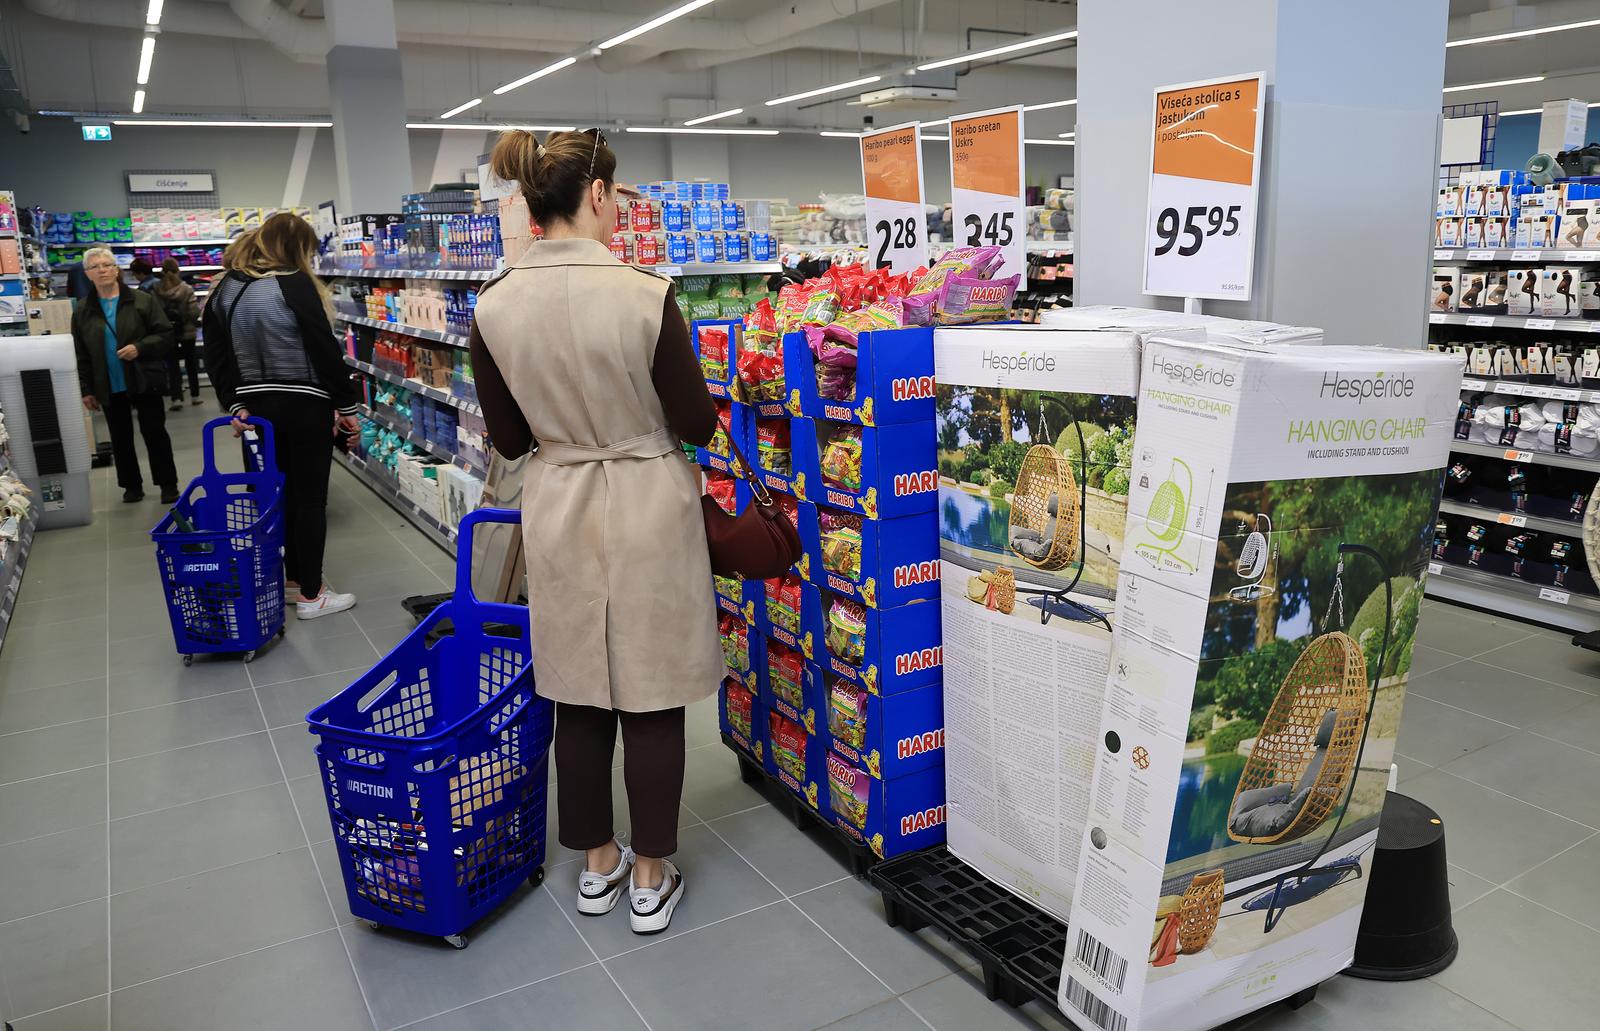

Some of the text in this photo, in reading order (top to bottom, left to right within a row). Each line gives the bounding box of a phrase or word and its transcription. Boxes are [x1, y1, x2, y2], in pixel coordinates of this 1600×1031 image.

[1160, 90, 1241, 110] Viseća stolica s
[956, 122, 1000, 136] Haribo sretan
[865, 134, 914, 150] Haribo pearl eggs
[955, 136, 974, 148] Uskrs
[637, 216, 650, 226] BAR
[668, 216, 681, 225] BAR
[698, 216, 710, 225] BAR
[724, 216, 736, 224] BAR
[642, 249, 656, 258] BAR
[674, 248, 686, 258] BAR
[702, 248, 715, 257] BAR
[728, 248, 740, 256] BAR
[756, 246, 768, 255] BAR
[970, 284, 1008, 302] HARIBO
[759, 404, 784, 416] HARIBO
[1147, 388, 1232, 416] HANGING CHAIR
[824, 404, 852, 421] HARIBO
[1288, 418, 1426, 444] HANGING CHAIR
[1307, 446, 1410, 460] INCLUDING STAND AND CUSHION
[709, 456, 728, 472] HARIBO
[765, 474, 788, 492] HARIBO
[828, 490, 855, 508] HARIBO
[188, 563, 219, 572] ACTION
[828, 574, 855, 596] HARIBO
[720, 596, 739, 616] HARIBO
[772, 626, 796, 648] HARIBO
[830, 656, 857, 680] HARIBO
[776, 698, 798, 722] HARIBO
[832, 738, 860, 763] HARIBO
[778, 768, 801, 793] HARIBO
[353, 780, 393, 799] ACTION
[836, 816, 864, 842] HARIBO
